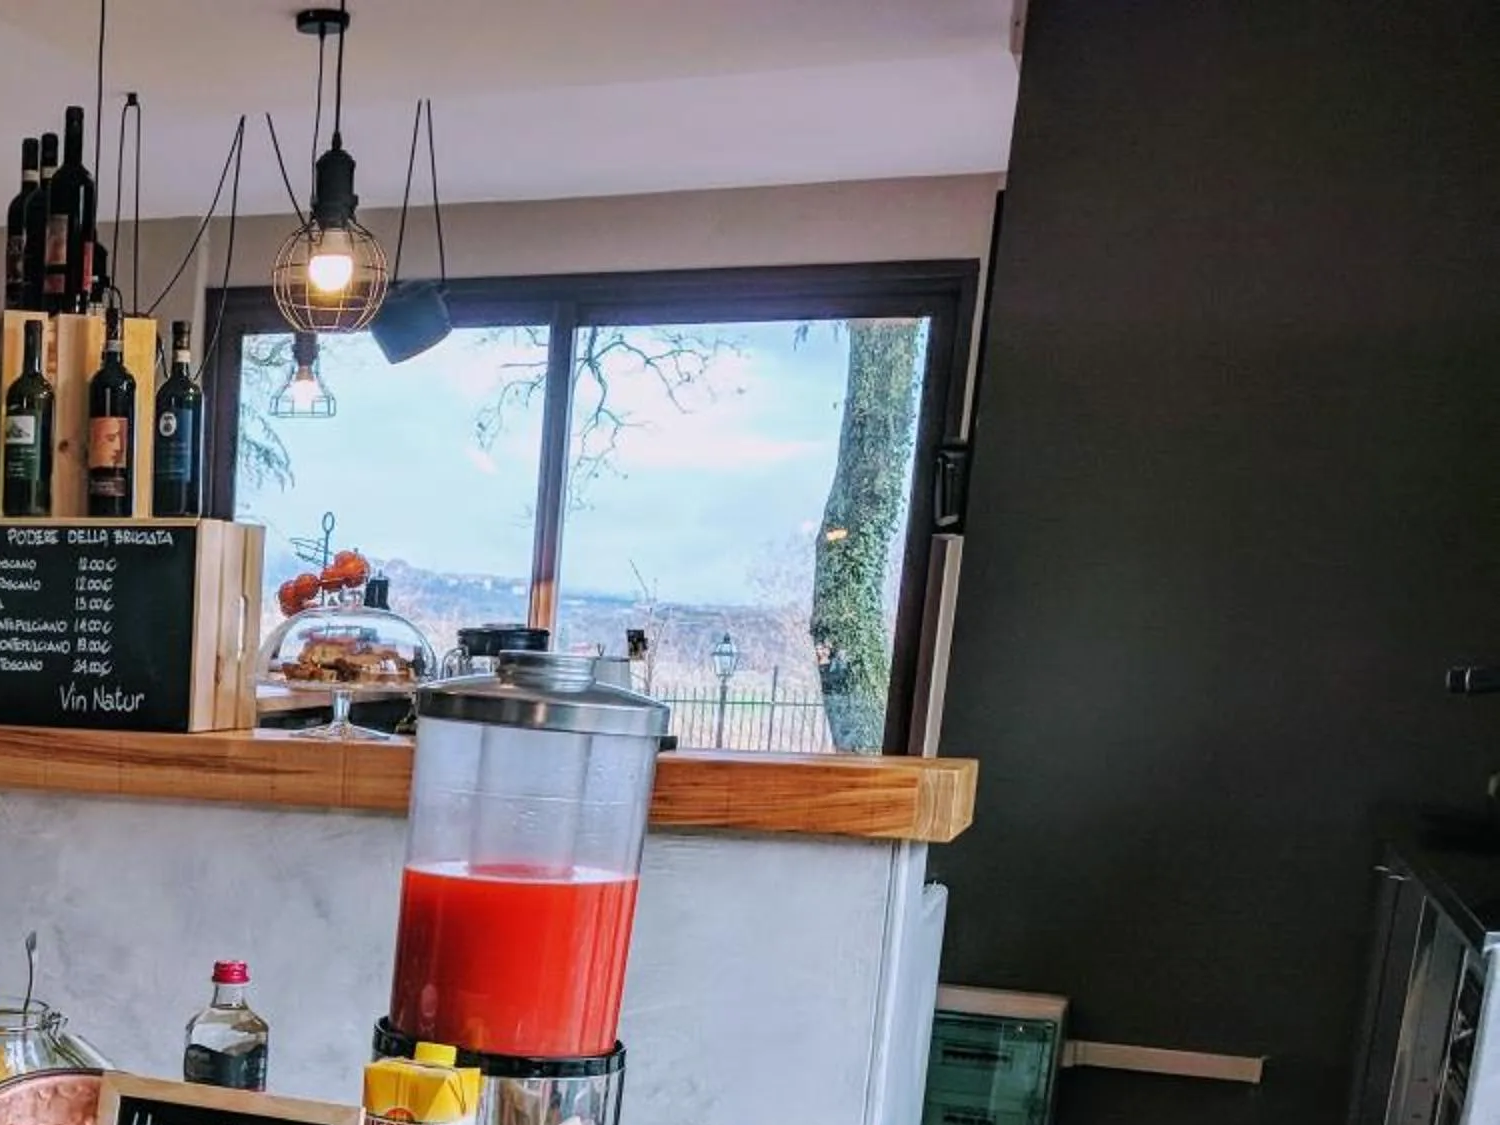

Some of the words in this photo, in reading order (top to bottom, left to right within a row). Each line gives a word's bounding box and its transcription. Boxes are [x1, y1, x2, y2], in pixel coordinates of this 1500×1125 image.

[7, 529, 59, 546] PODERE
[67, 529, 108, 547] DELLA
[0, 656, 43, 671] TOSCANO
[59, 682, 88, 712] Vin
[93, 685, 145, 713] Natur
